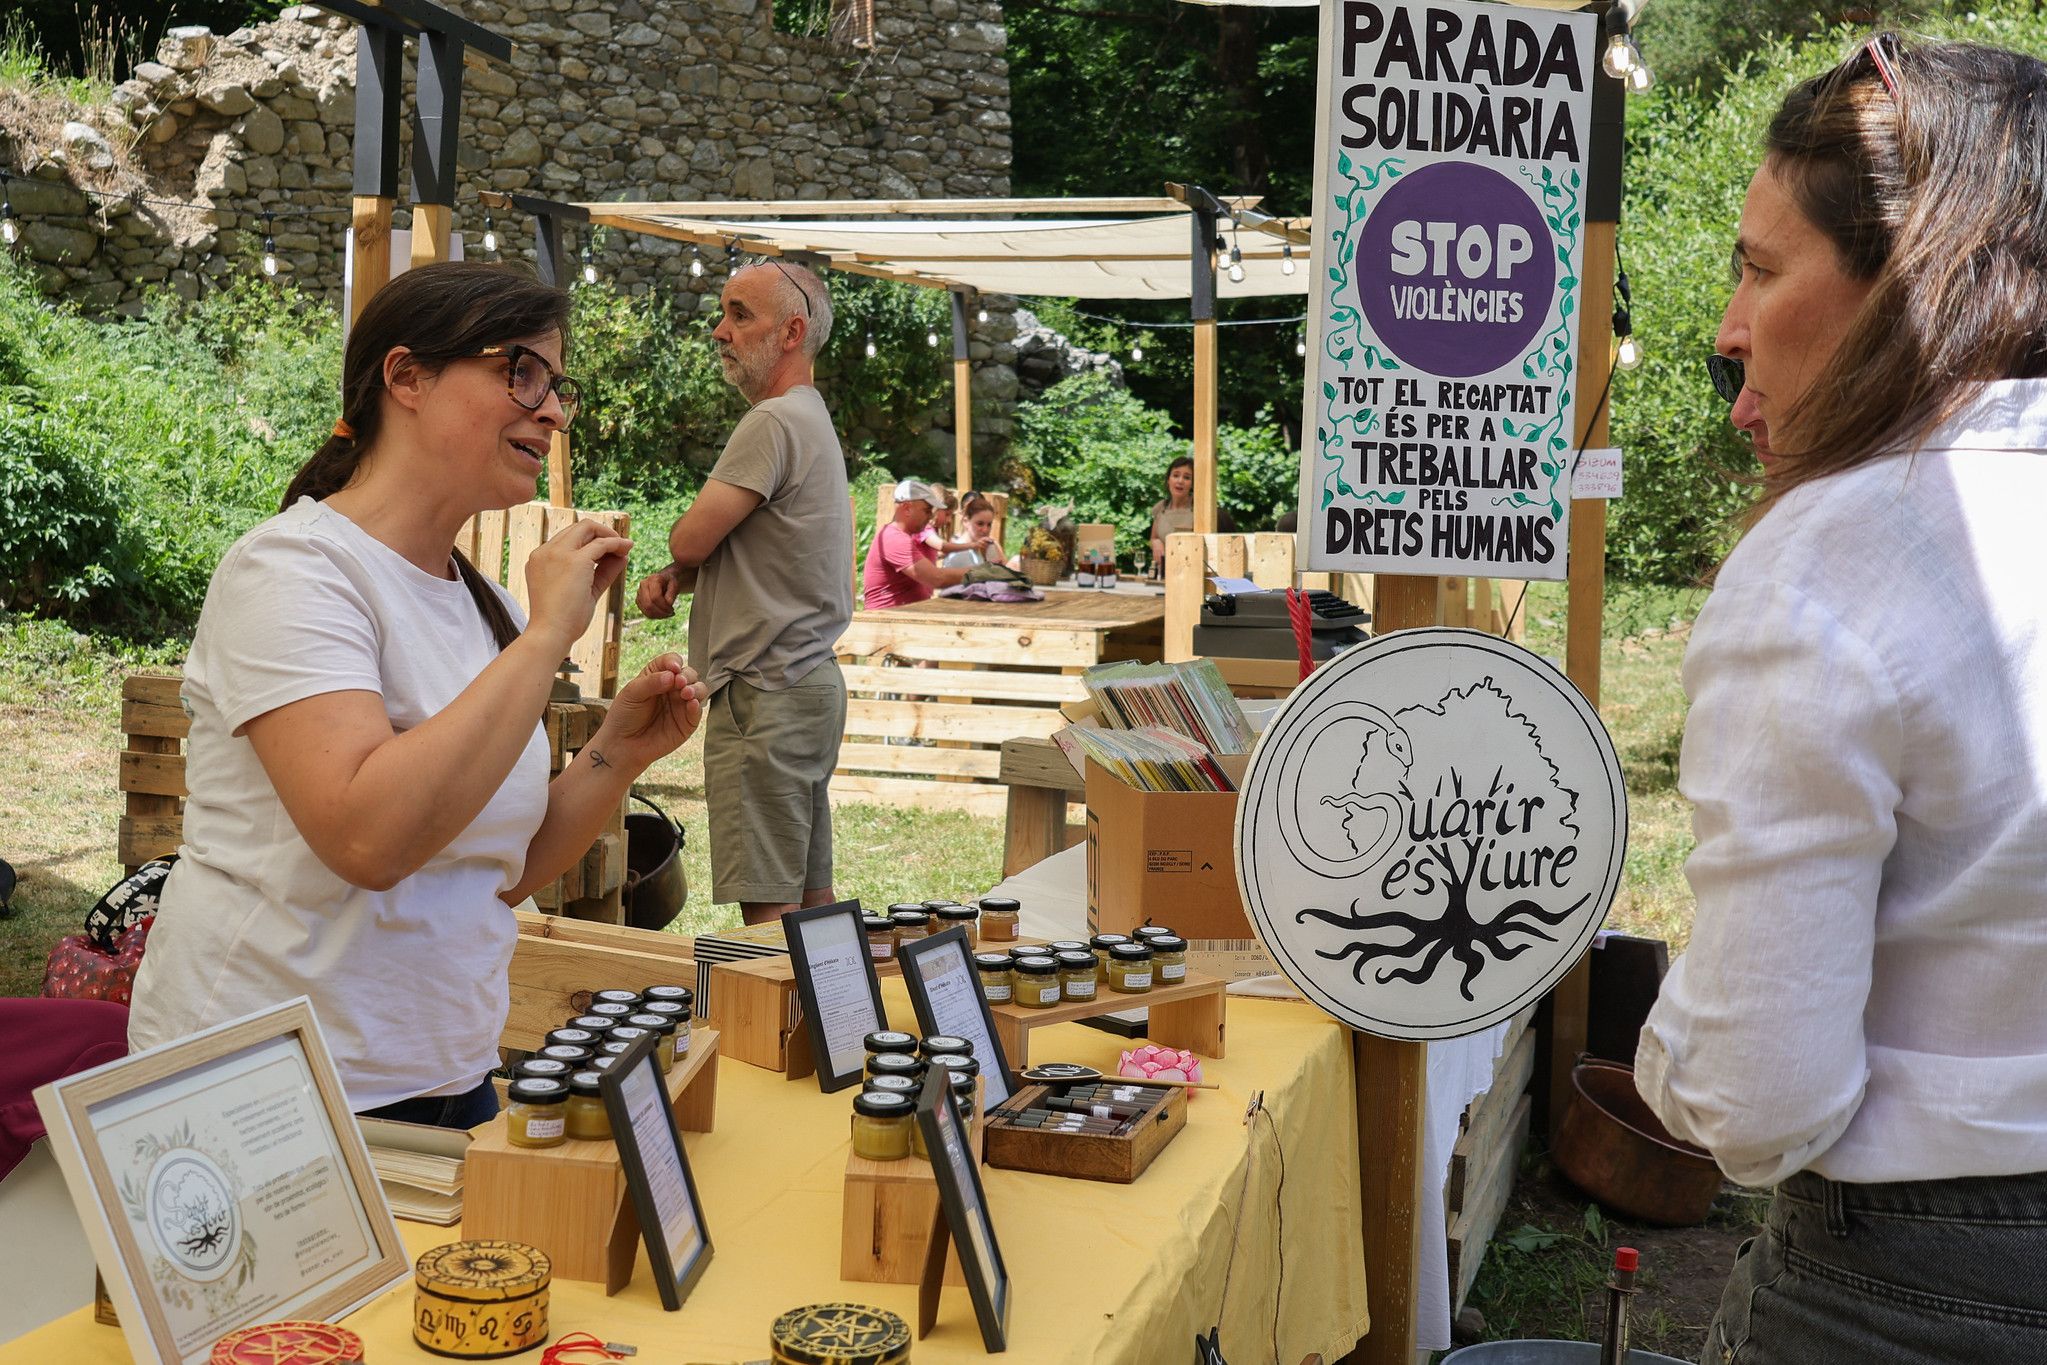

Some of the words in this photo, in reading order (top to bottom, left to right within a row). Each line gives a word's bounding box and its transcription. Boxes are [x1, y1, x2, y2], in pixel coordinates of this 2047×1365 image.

[1342, 0, 1584, 92] PARADA
[1341, 83, 1580, 163] SOLIDÀRIA
[1390, 220, 1533, 279] STOP
[1390, 280, 1524, 323] VIOLÈNCIES
[1338, 376, 1384, 405] TOT
[1395, 378, 1427, 407] EL
[1438, 381, 1551, 414] RECAPTAT
[1385, 407, 1417, 438] ÉS
[1427, 413, 1469, 441] PER
[1480, 417, 1496, 442] A
[1351, 441, 1539, 490] TREBALLAR
[1419, 488, 1468, 511] PELS
[1326, 507, 1424, 556] DRETS
[1431, 513, 1556, 564] HUMANS
[1381, 845, 1435, 899] és
